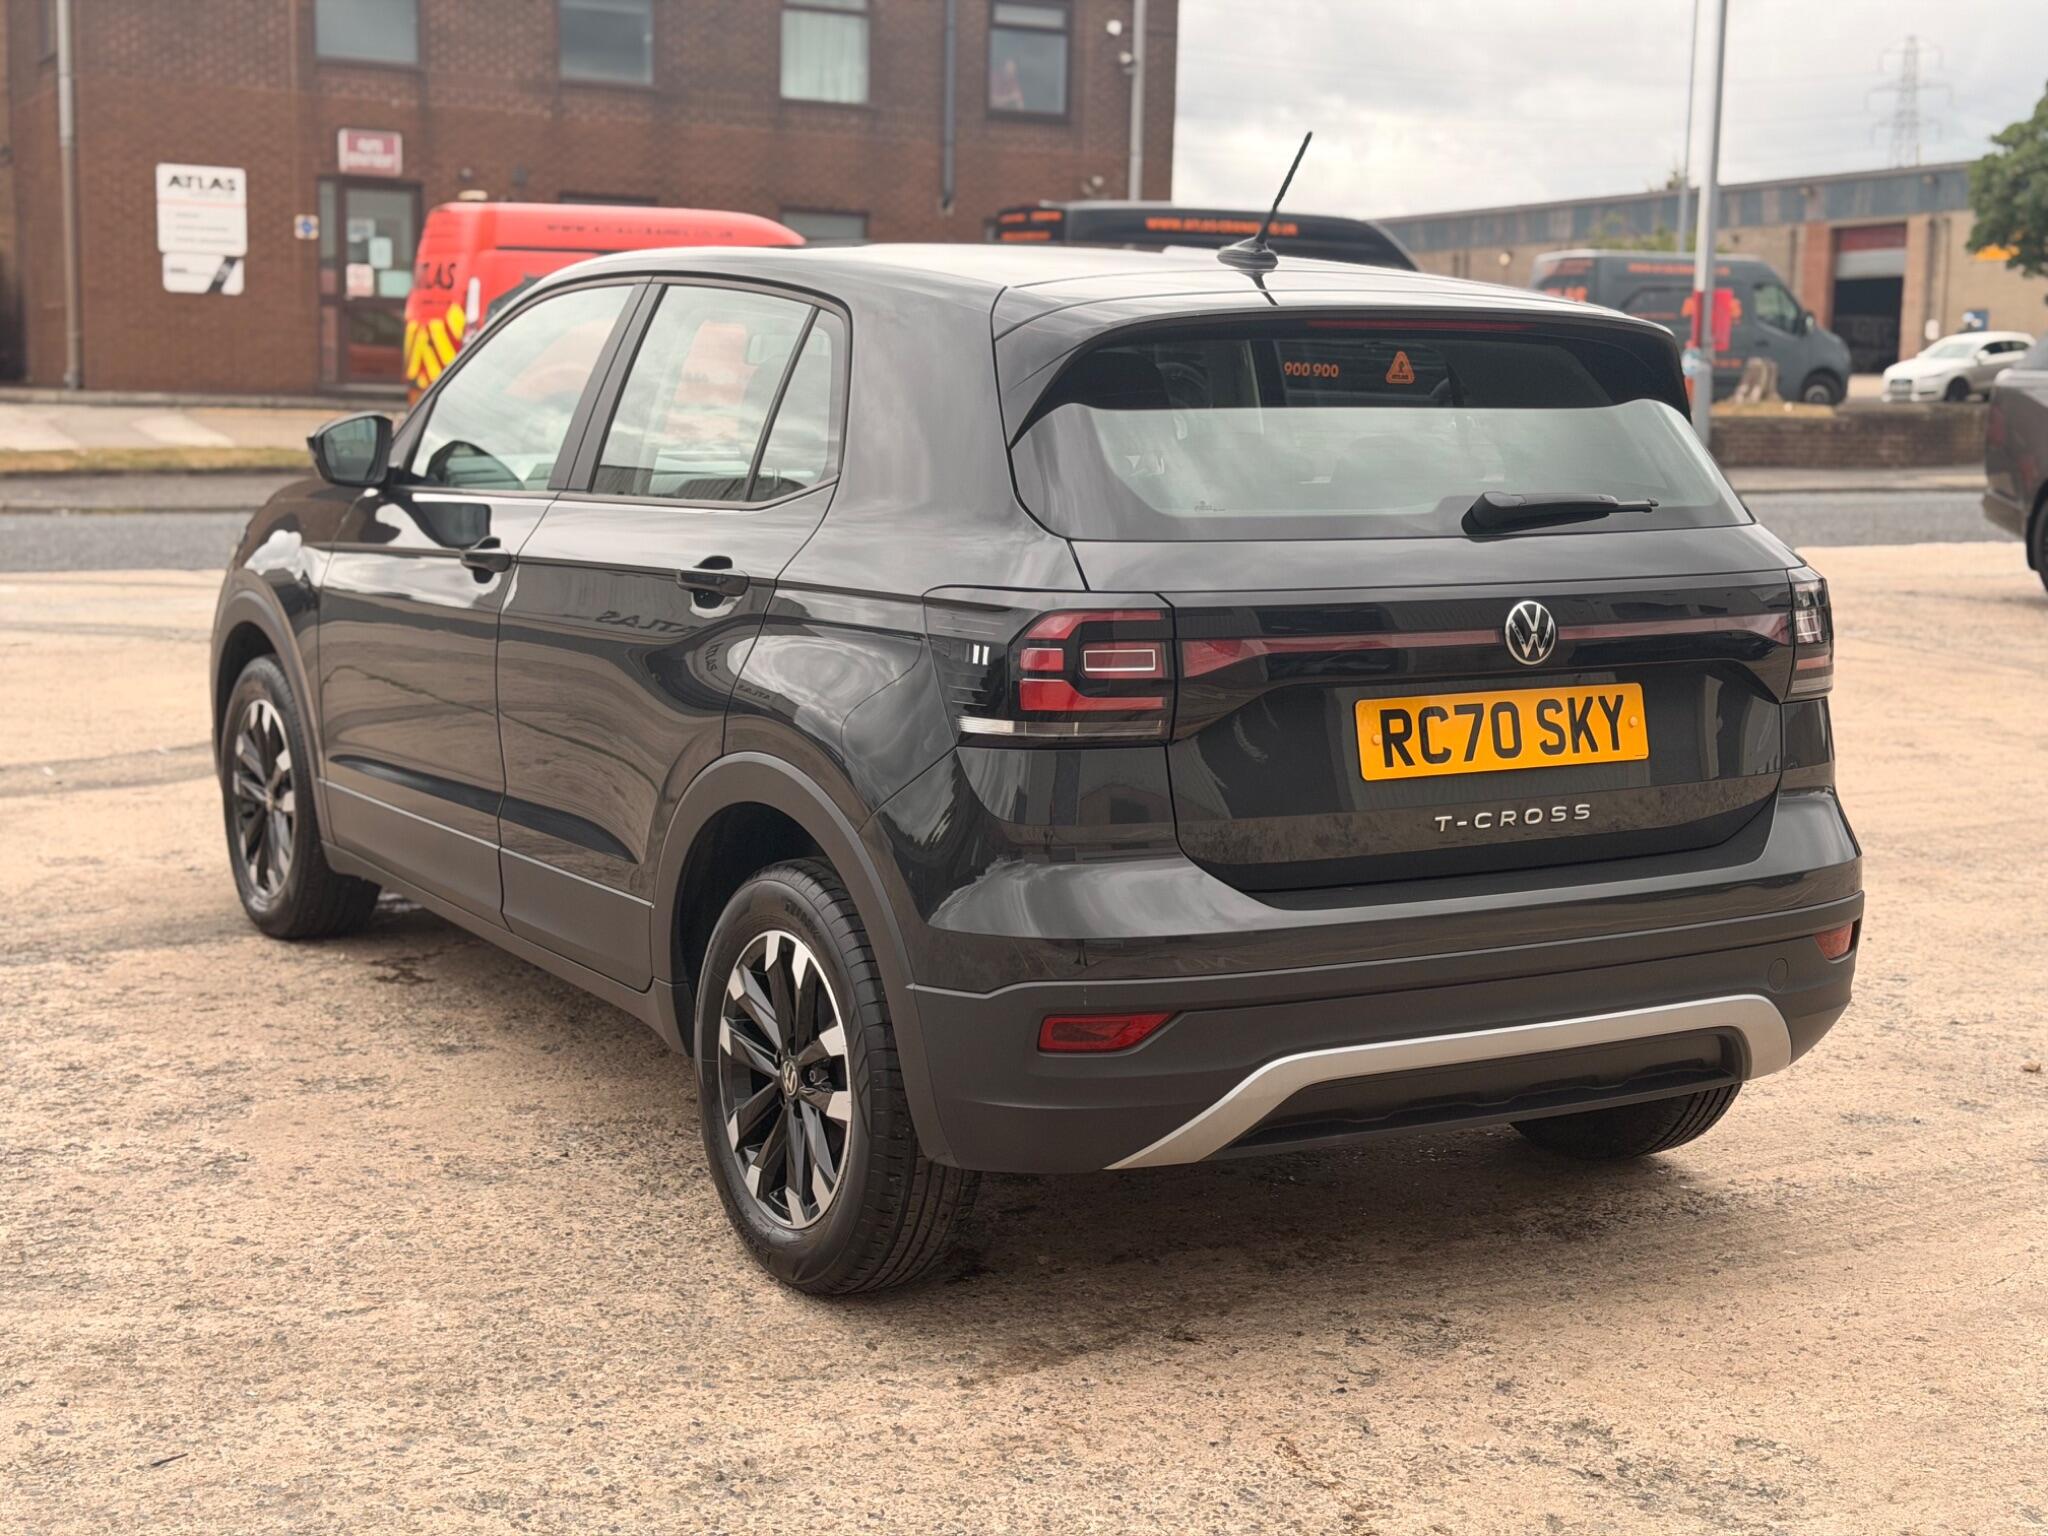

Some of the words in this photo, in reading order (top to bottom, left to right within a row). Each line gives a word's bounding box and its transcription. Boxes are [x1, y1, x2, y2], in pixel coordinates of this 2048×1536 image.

[168, 175, 236, 191] ATLAS
[1284, 361, 1310, 376] 900
[1312, 362, 1339, 378] 900
[1507, 602, 1553, 661] VW
[1379, 701, 1523, 768] RC70
[1536, 694, 1624, 756] SKY
[1435, 803, 1591, 832] T-CROSS
